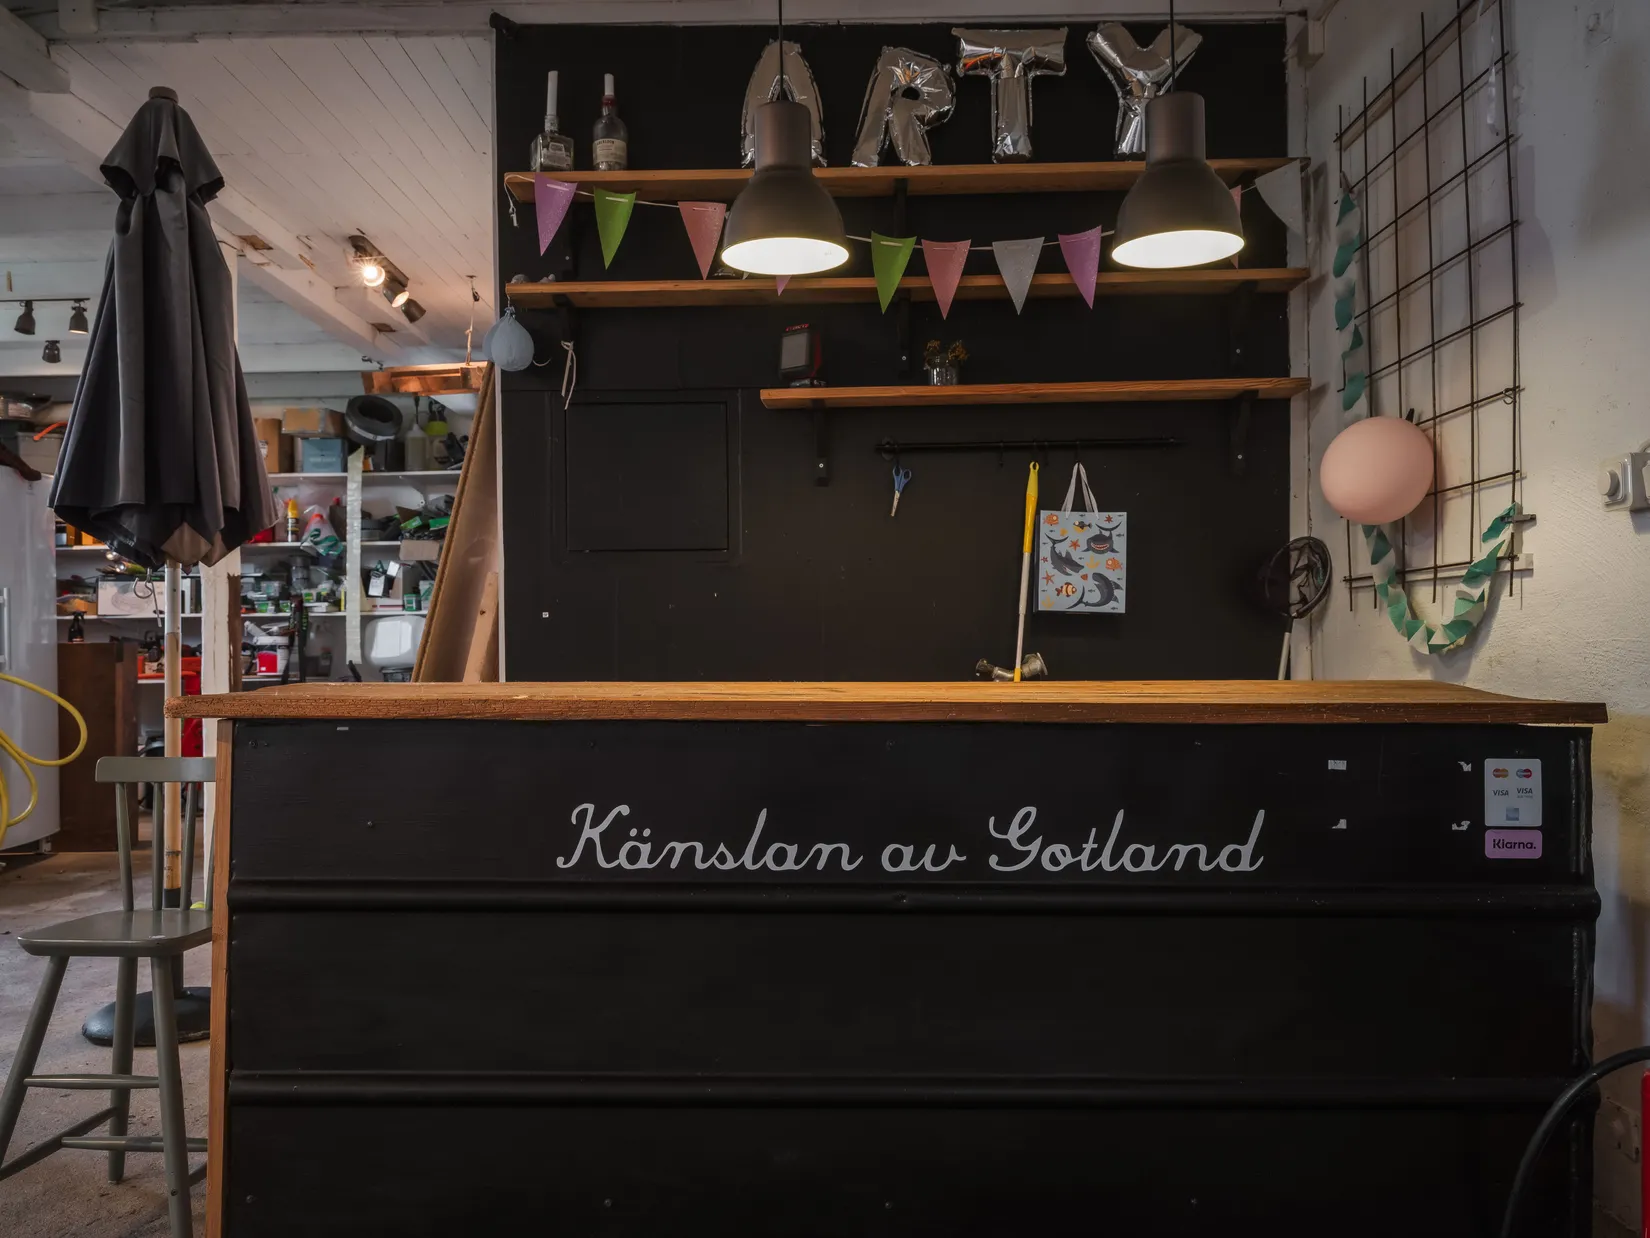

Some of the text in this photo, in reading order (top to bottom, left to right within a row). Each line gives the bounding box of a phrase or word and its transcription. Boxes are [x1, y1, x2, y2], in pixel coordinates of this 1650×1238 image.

[557, 803, 1264, 872] Känslan av Gotland
[1492, 839, 1537, 850] Klarna.
